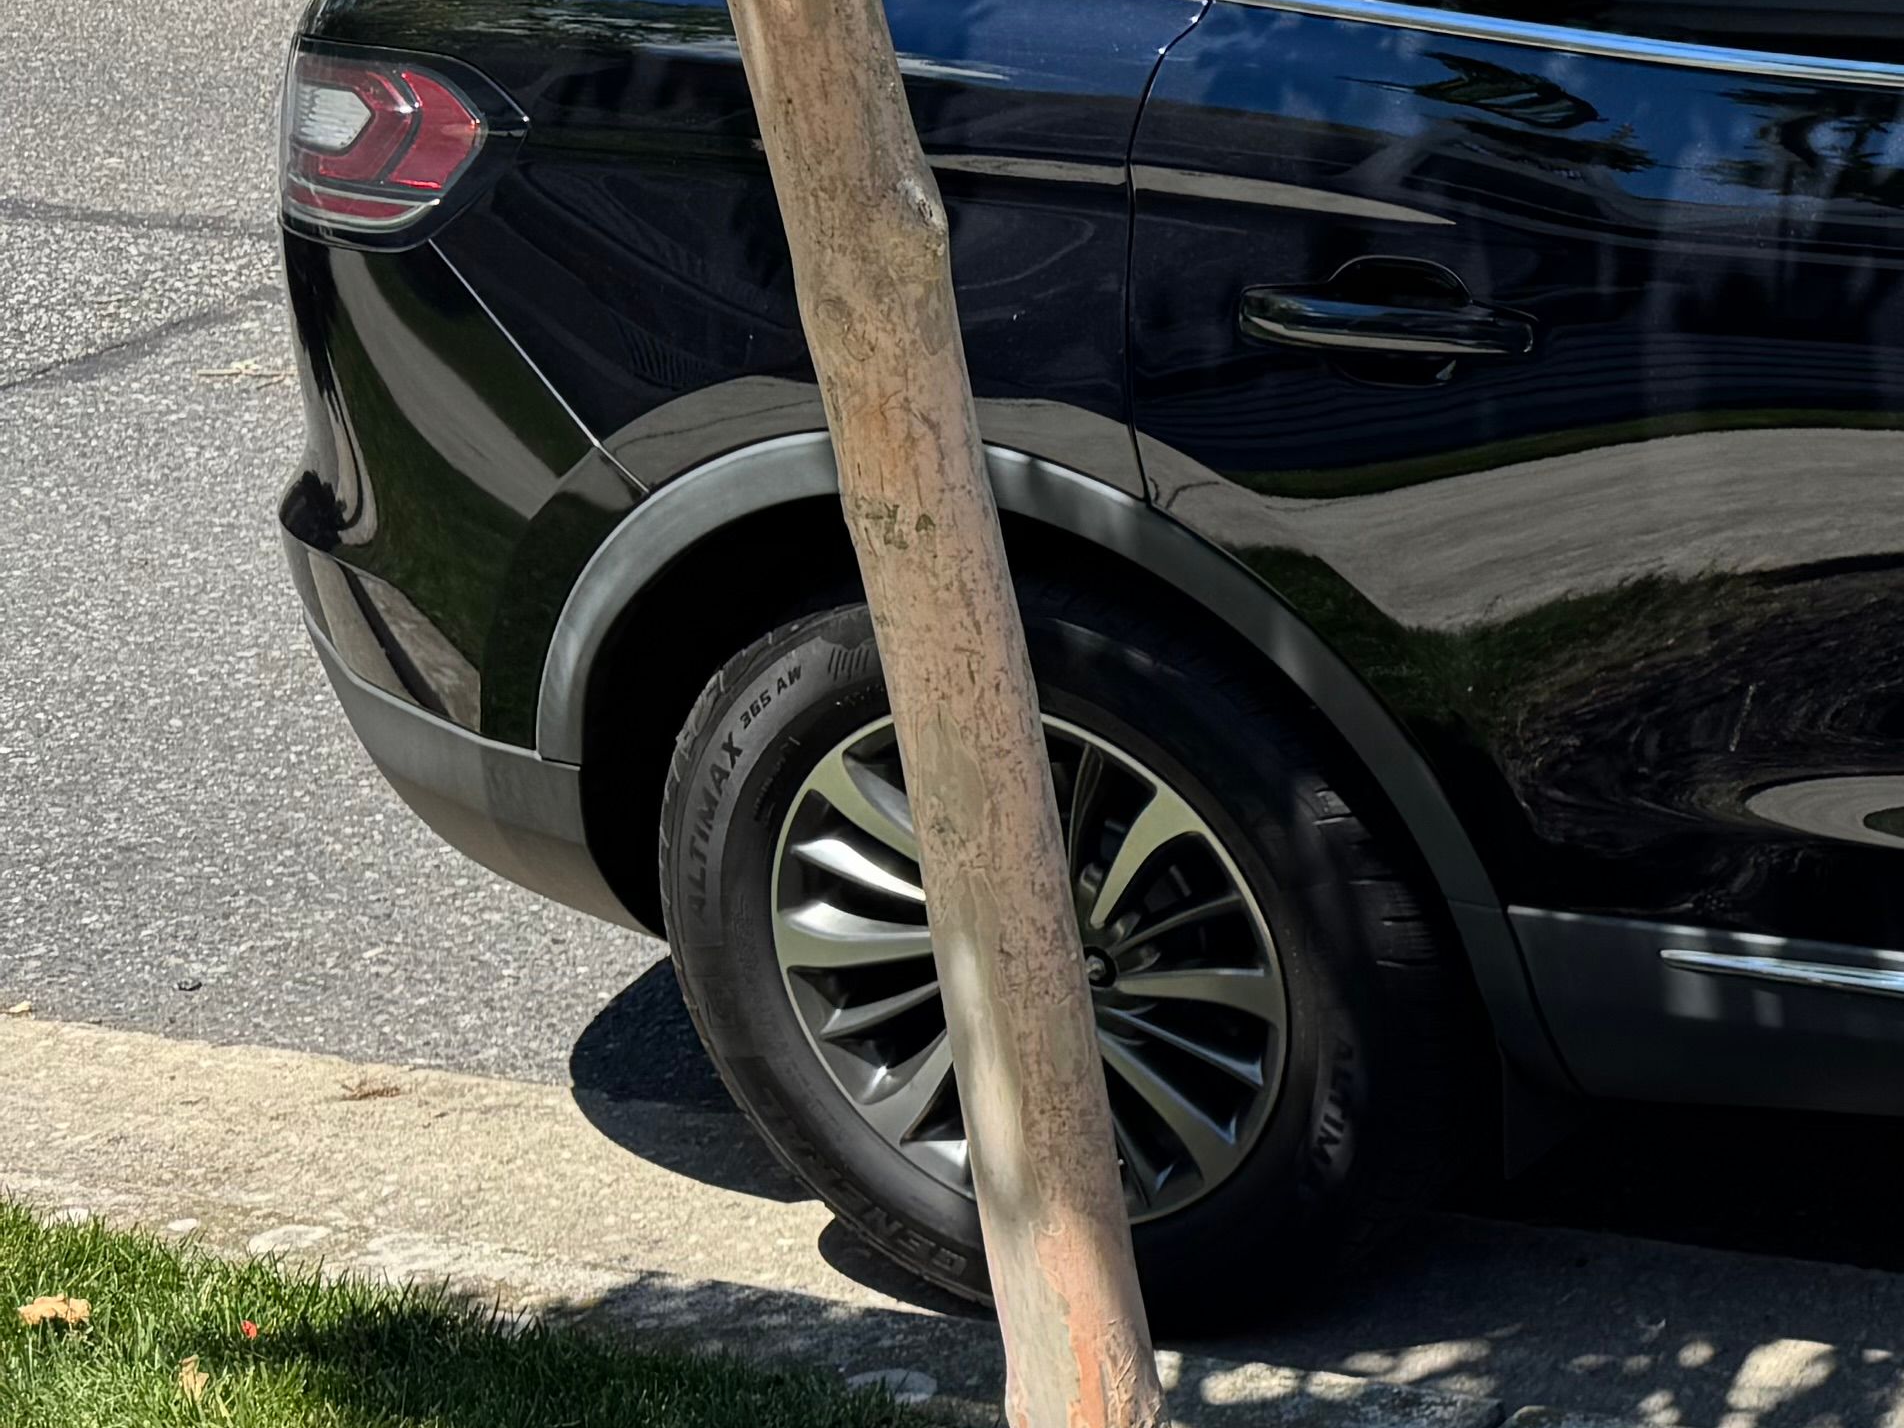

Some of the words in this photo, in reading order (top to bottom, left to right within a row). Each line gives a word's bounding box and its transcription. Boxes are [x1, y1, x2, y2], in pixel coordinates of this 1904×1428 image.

[686, 729, 746, 922] ALTIMAX
[739, 689, 772, 731] 365
[775, 664, 803, 697] AW
